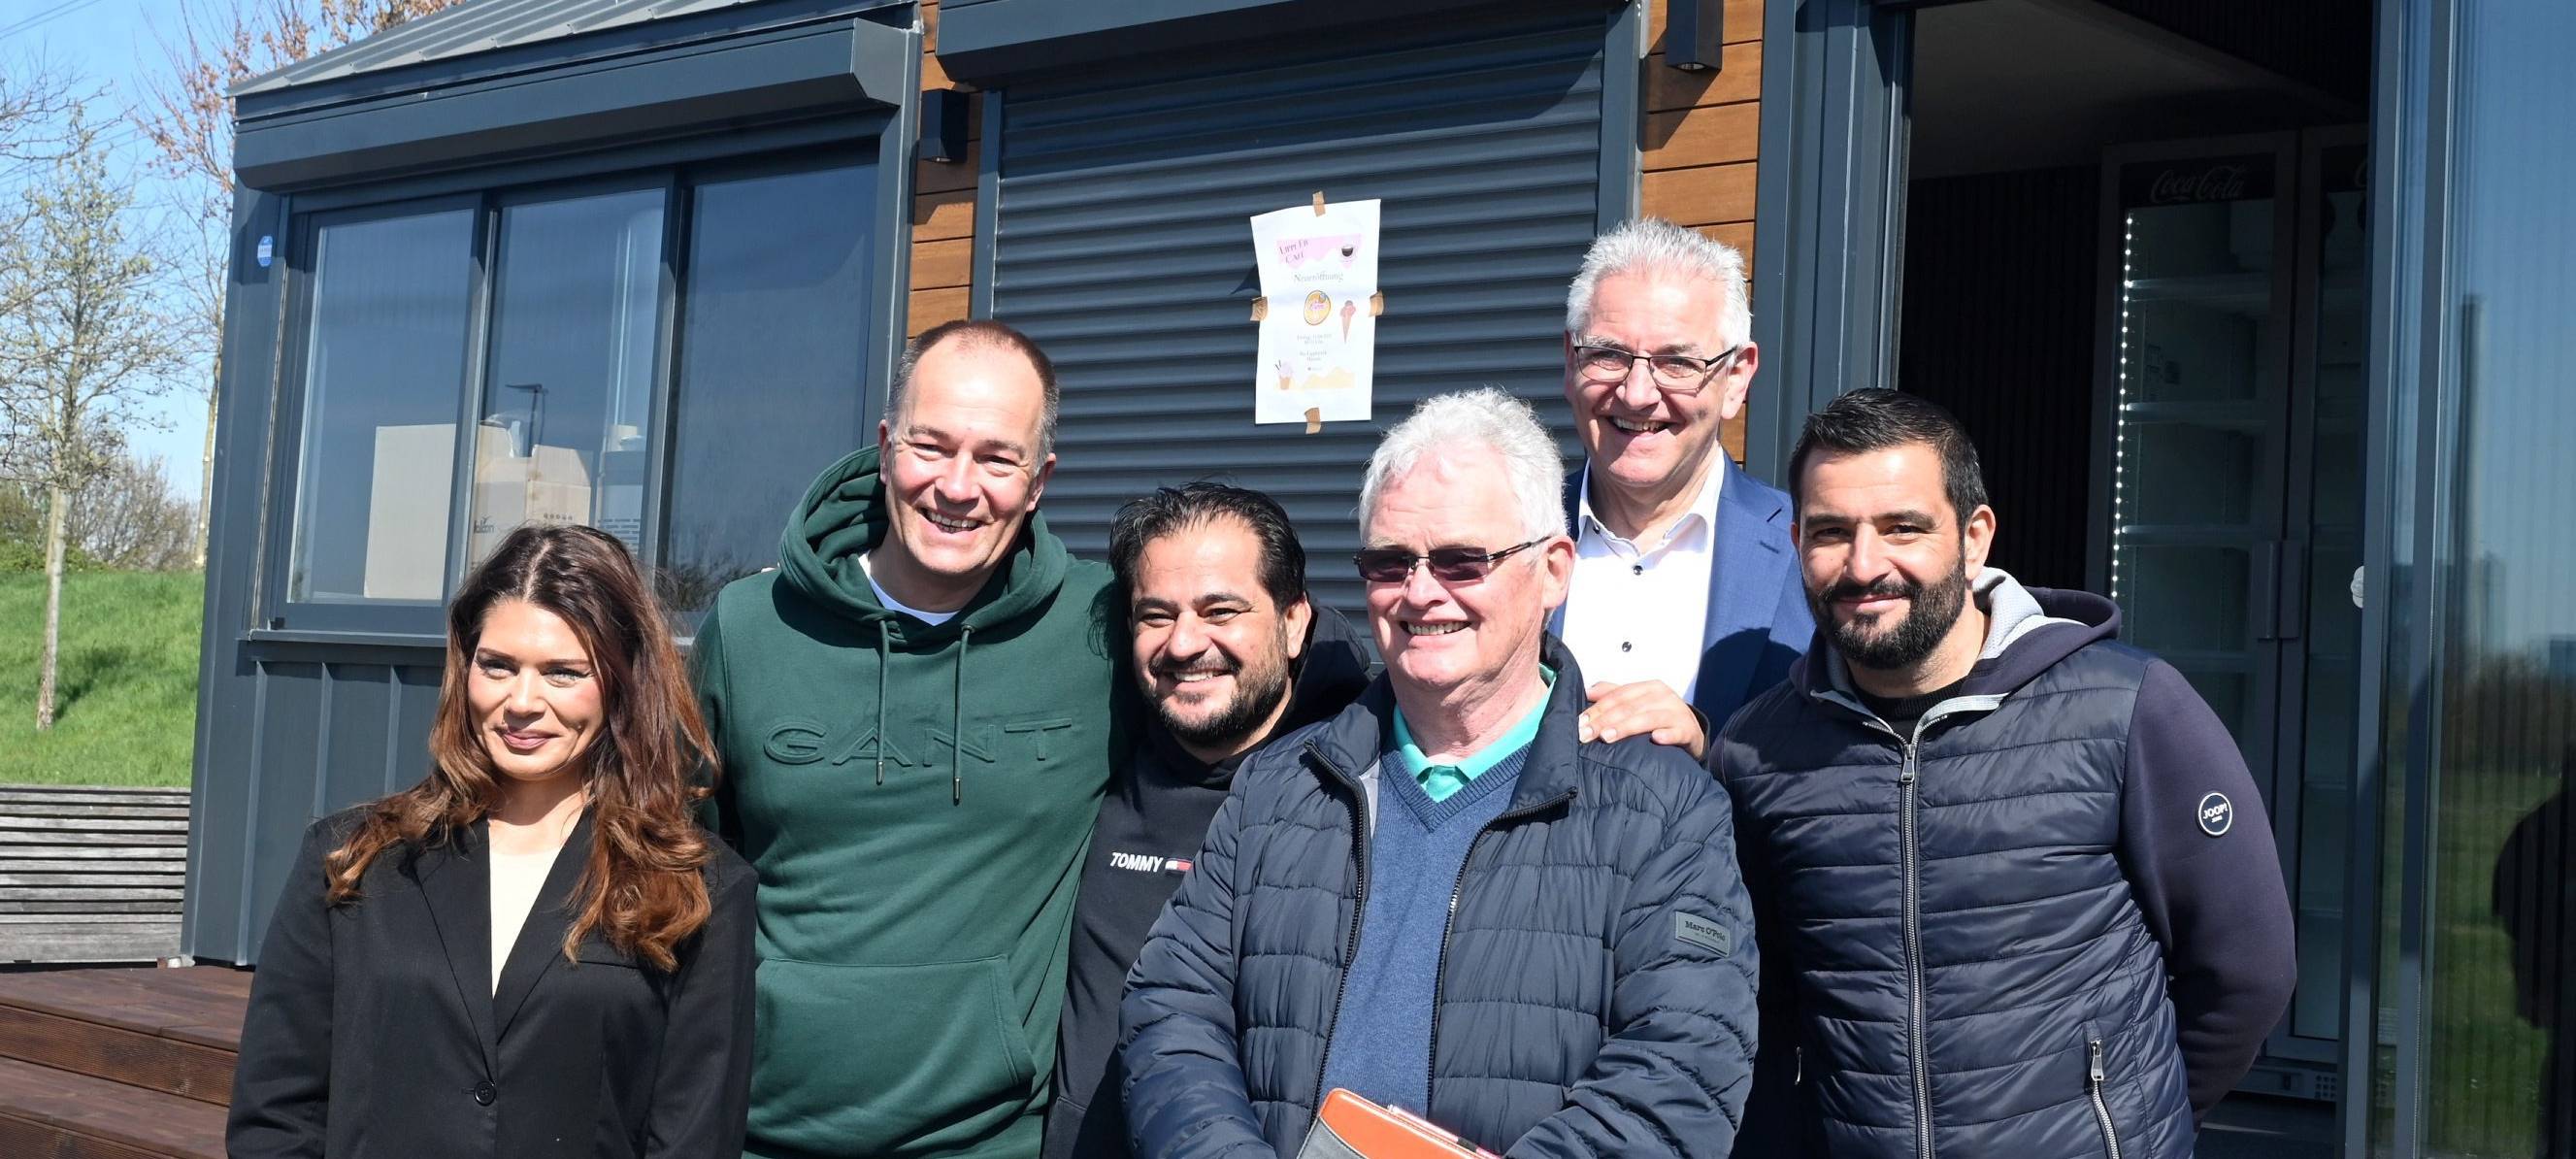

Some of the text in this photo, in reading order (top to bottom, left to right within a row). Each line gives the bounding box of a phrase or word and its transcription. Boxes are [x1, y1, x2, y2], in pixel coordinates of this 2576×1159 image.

[763, 717, 1073, 767] GANT
[1109, 851, 1164, 873] TOMMY
[1685, 920, 1705, 933] Marc
